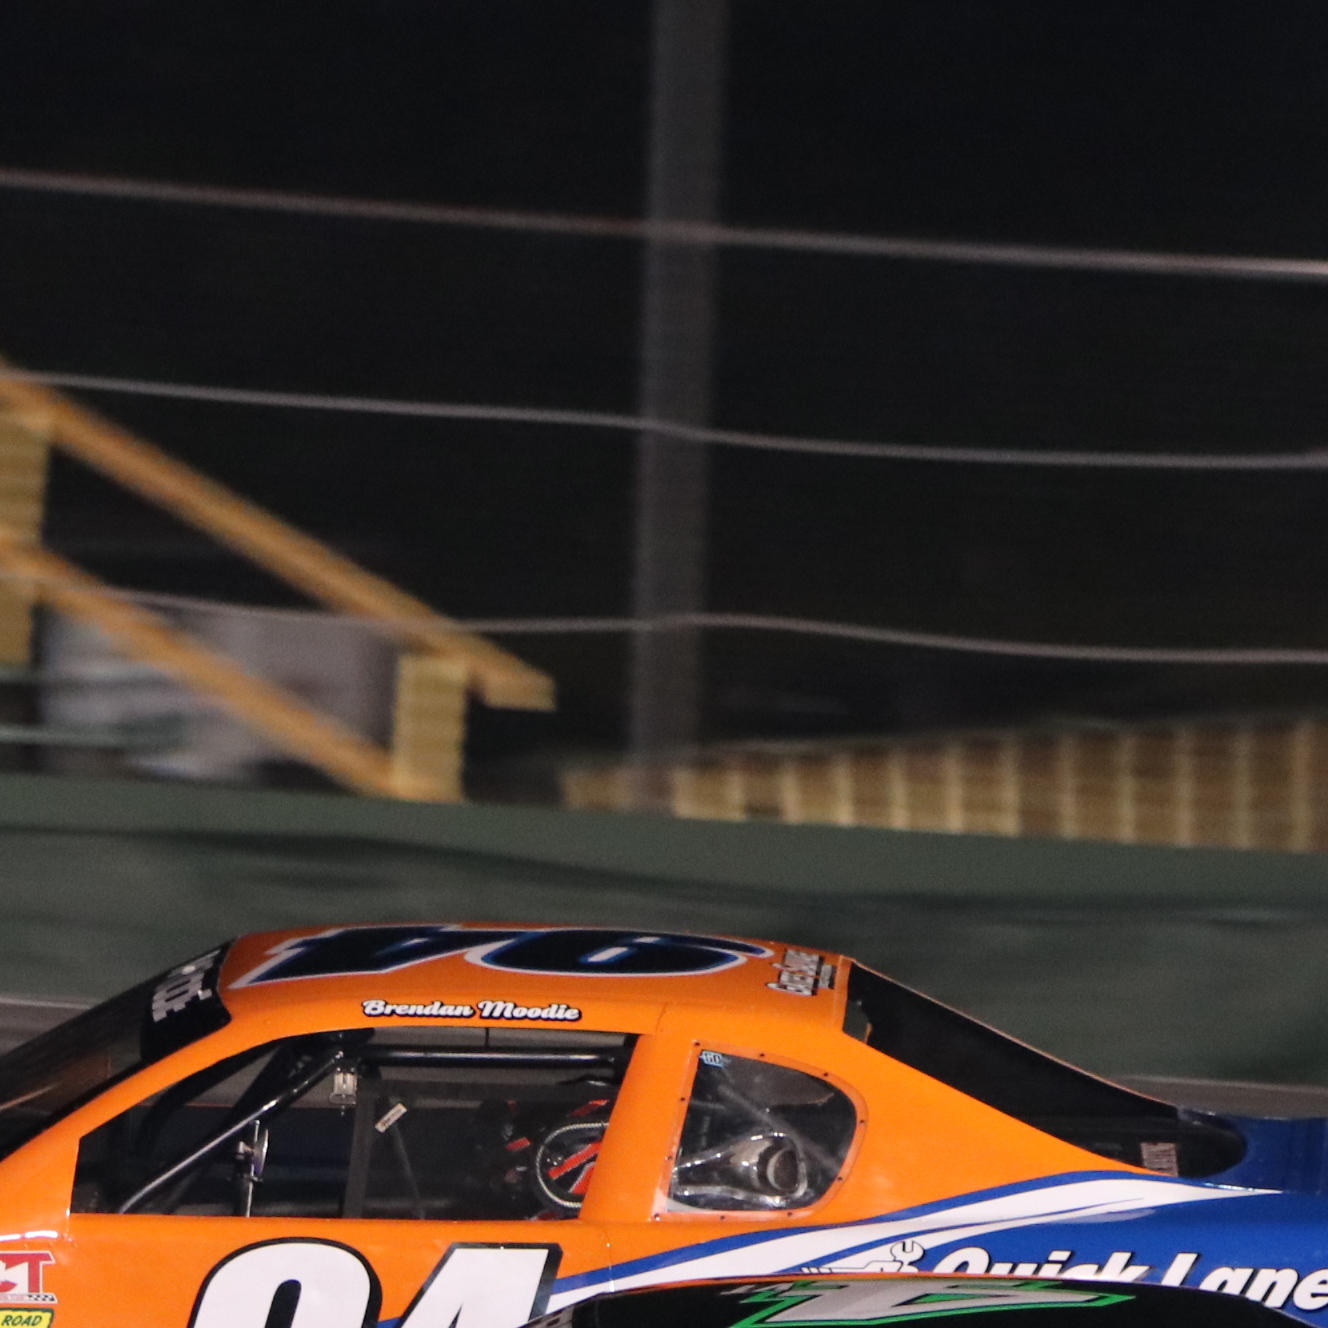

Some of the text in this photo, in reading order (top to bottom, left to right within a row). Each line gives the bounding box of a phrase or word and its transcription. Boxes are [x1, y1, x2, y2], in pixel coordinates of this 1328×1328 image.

[362, 1000, 580, 1021] Brendan Moodie
[1, 1315, 43, 1326] ROAD
